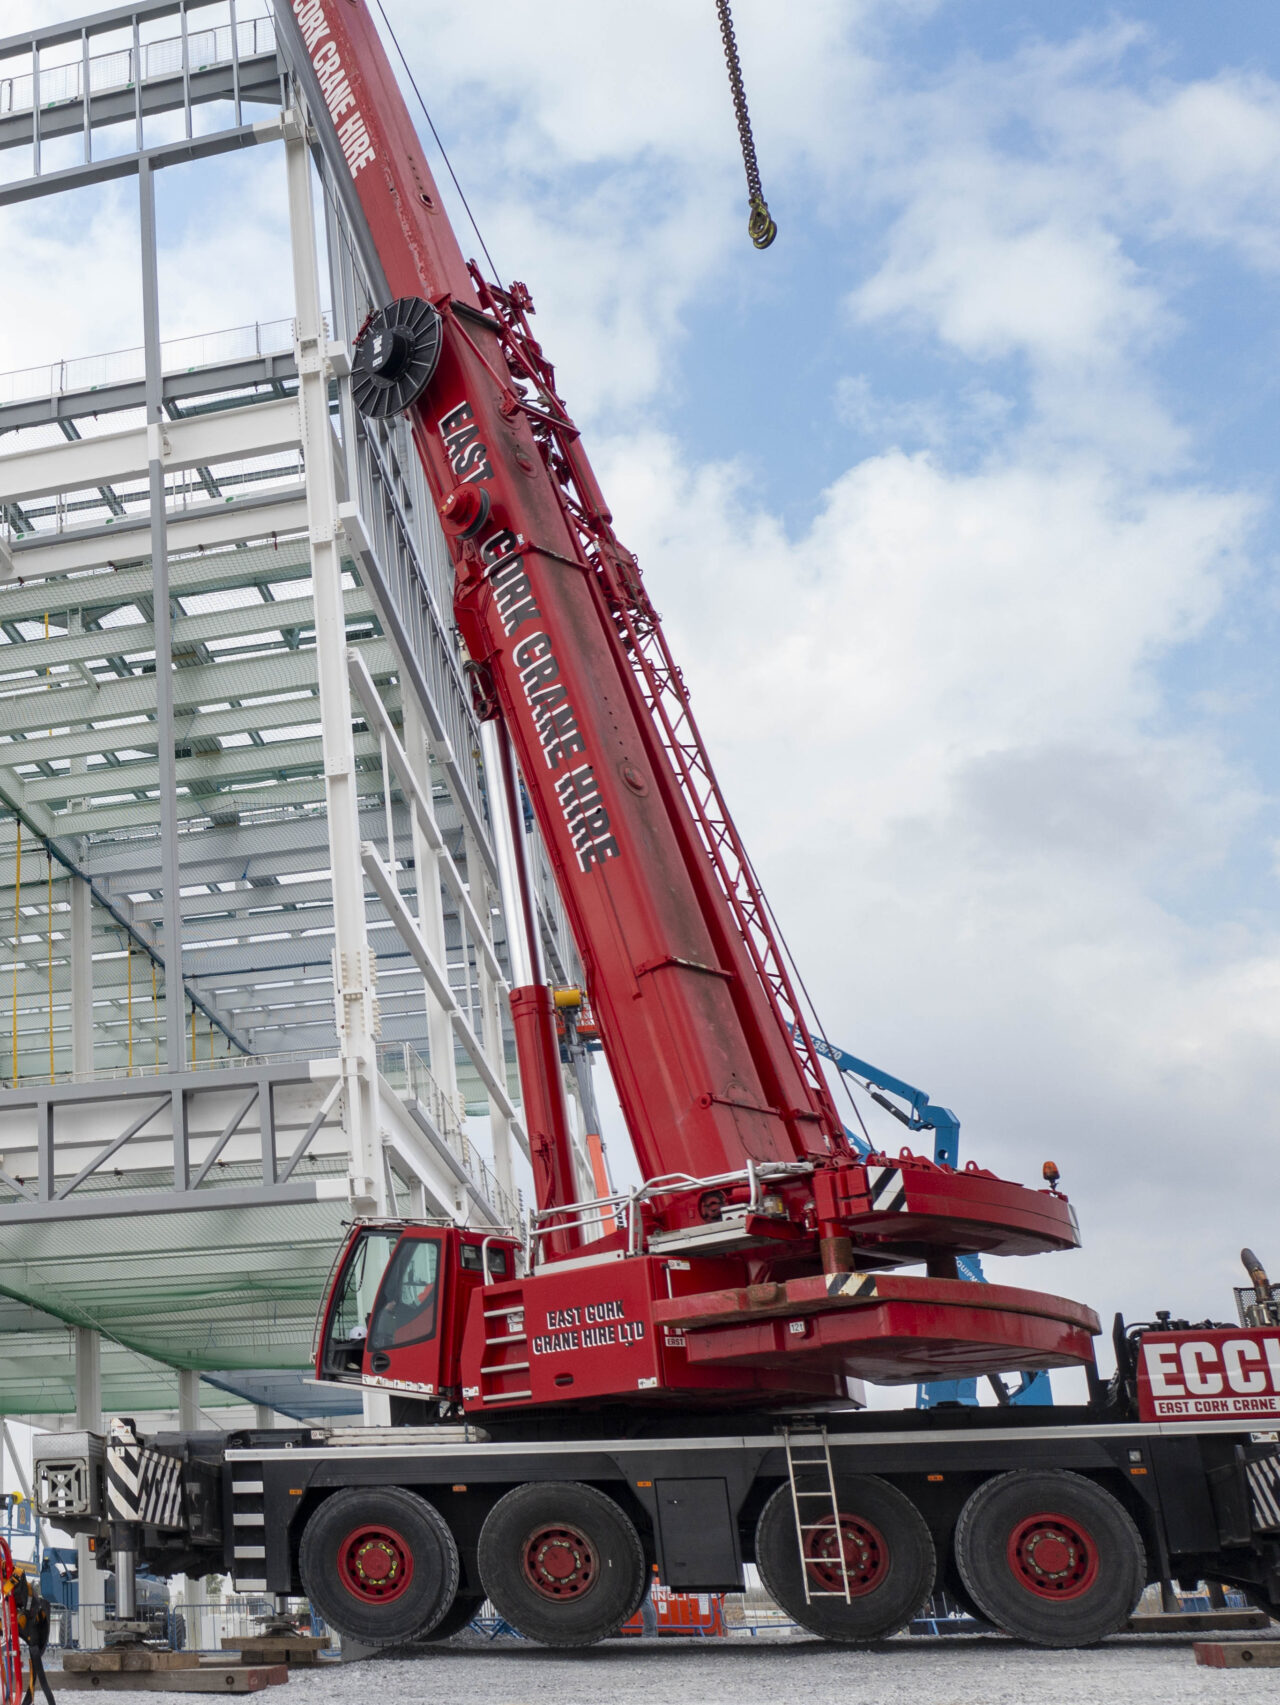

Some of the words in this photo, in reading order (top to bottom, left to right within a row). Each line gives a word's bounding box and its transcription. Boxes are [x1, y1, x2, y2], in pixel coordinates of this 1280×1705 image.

[312, 40, 356, 125] CRANE
[337, 110, 376, 179] HIRE
[437, 400, 495, 484] EAST
[480, 529, 542, 637] CORK
[512, 631, 587, 770] CRANE
[554, 763, 621, 873] HIRE
[546, 1306, 582, 1330] EAST
[585, 1300, 625, 1324] CORK
[532, 1332, 578, 1355] CRANE
[581, 1325, 615, 1348] HIRE
[618, 1321, 645, 1343] LTD
[1158, 1401, 1190, 1414] EAST
[1194, 1400, 1230, 1412] CORK
[1233, 1399, 1278, 1411] CRANE
